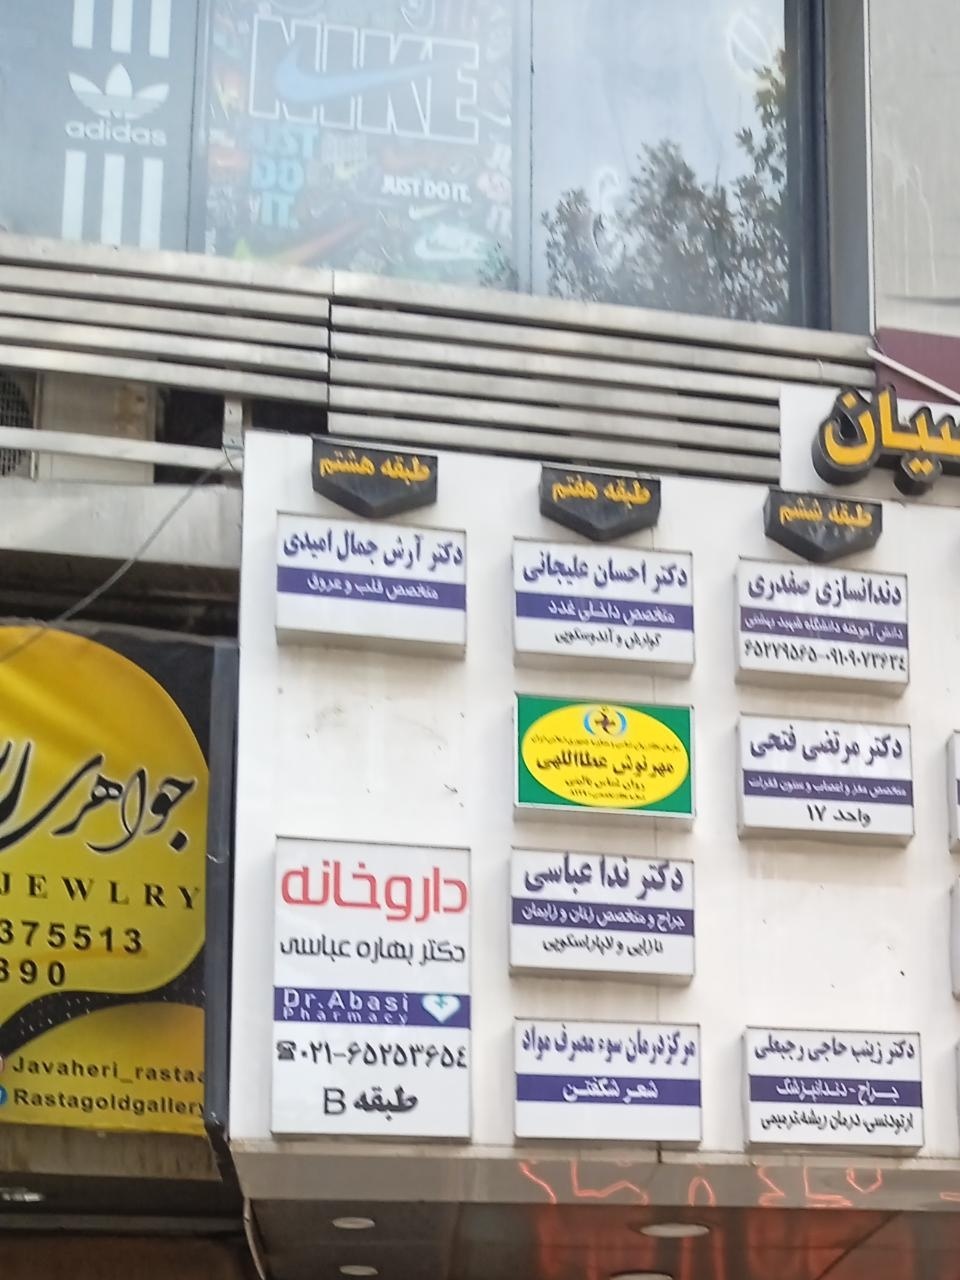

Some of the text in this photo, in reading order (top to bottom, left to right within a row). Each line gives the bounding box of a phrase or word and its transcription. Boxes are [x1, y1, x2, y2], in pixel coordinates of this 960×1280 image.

[65, 120, 168, 147] adidas
[382, 174, 449, 200] JUST DO
[320, 450, 430, 486] طبقه هشتم
[552, 475, 651, 509] طبقه هفتم
[828, 503, 873, 532] طبقه
[283, 528, 463, 571] دکتر آرش جمال امیدی
[523, 551, 688, 593] دکتر احسان علیجانی
[750, 724, 902, 765] دکتر مرتضی فتحی
[807, 805, 871, 828] واحد ۱۷
[0, 872, 200, 910] JEWLRY
[281, 860, 468, 922] داروخانه
[525, 851, 684, 900] دکتر ندا عباسی
[0, 919, 142, 953] 375513
[280, 934, 351, 961] عباسی
[419, 939, 466, 966] دکتر
[808, 1036, 847, 1062] حاجی
[887, 1040, 914, 1065] دکتر
[323, 1085, 418, 1121] طبقه B
